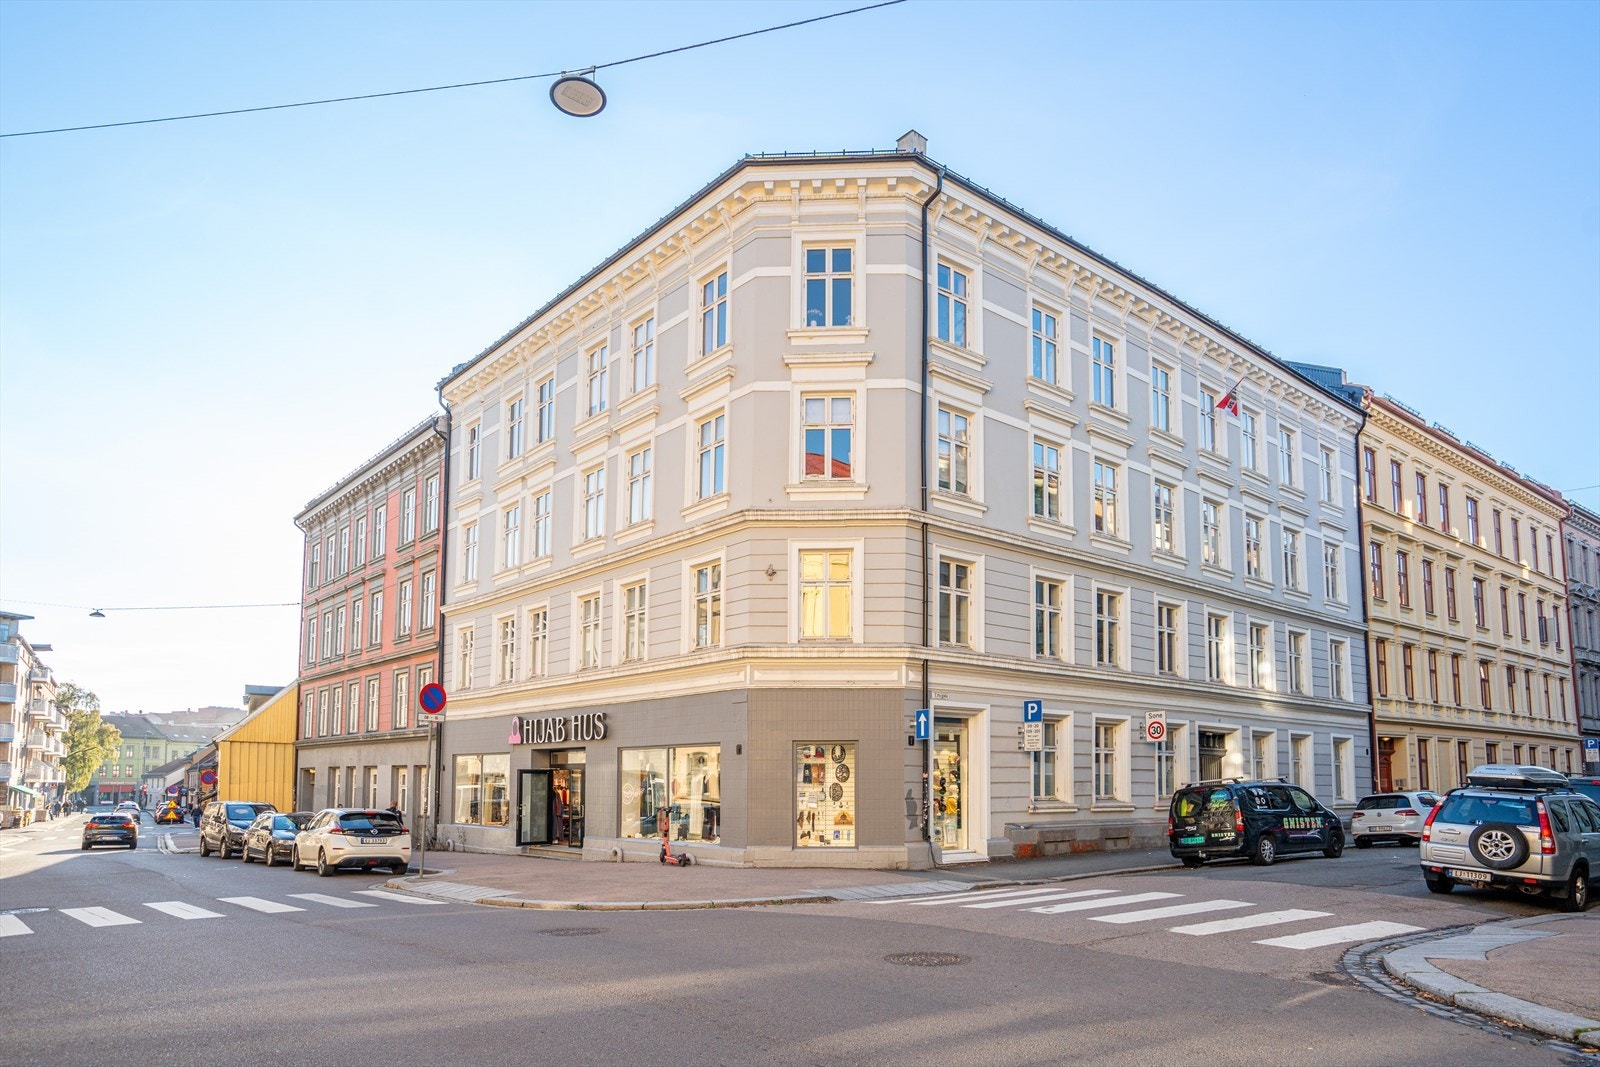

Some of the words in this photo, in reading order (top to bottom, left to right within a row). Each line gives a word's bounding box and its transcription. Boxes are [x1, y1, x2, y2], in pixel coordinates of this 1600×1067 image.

[1028, 703, 1038, 720] P
[523, 717, 566, 744] HIJAB
[571, 712, 606, 741] HUS
[1151, 726, 1162, 735] 30
[1587, 740, 1595, 748] P
